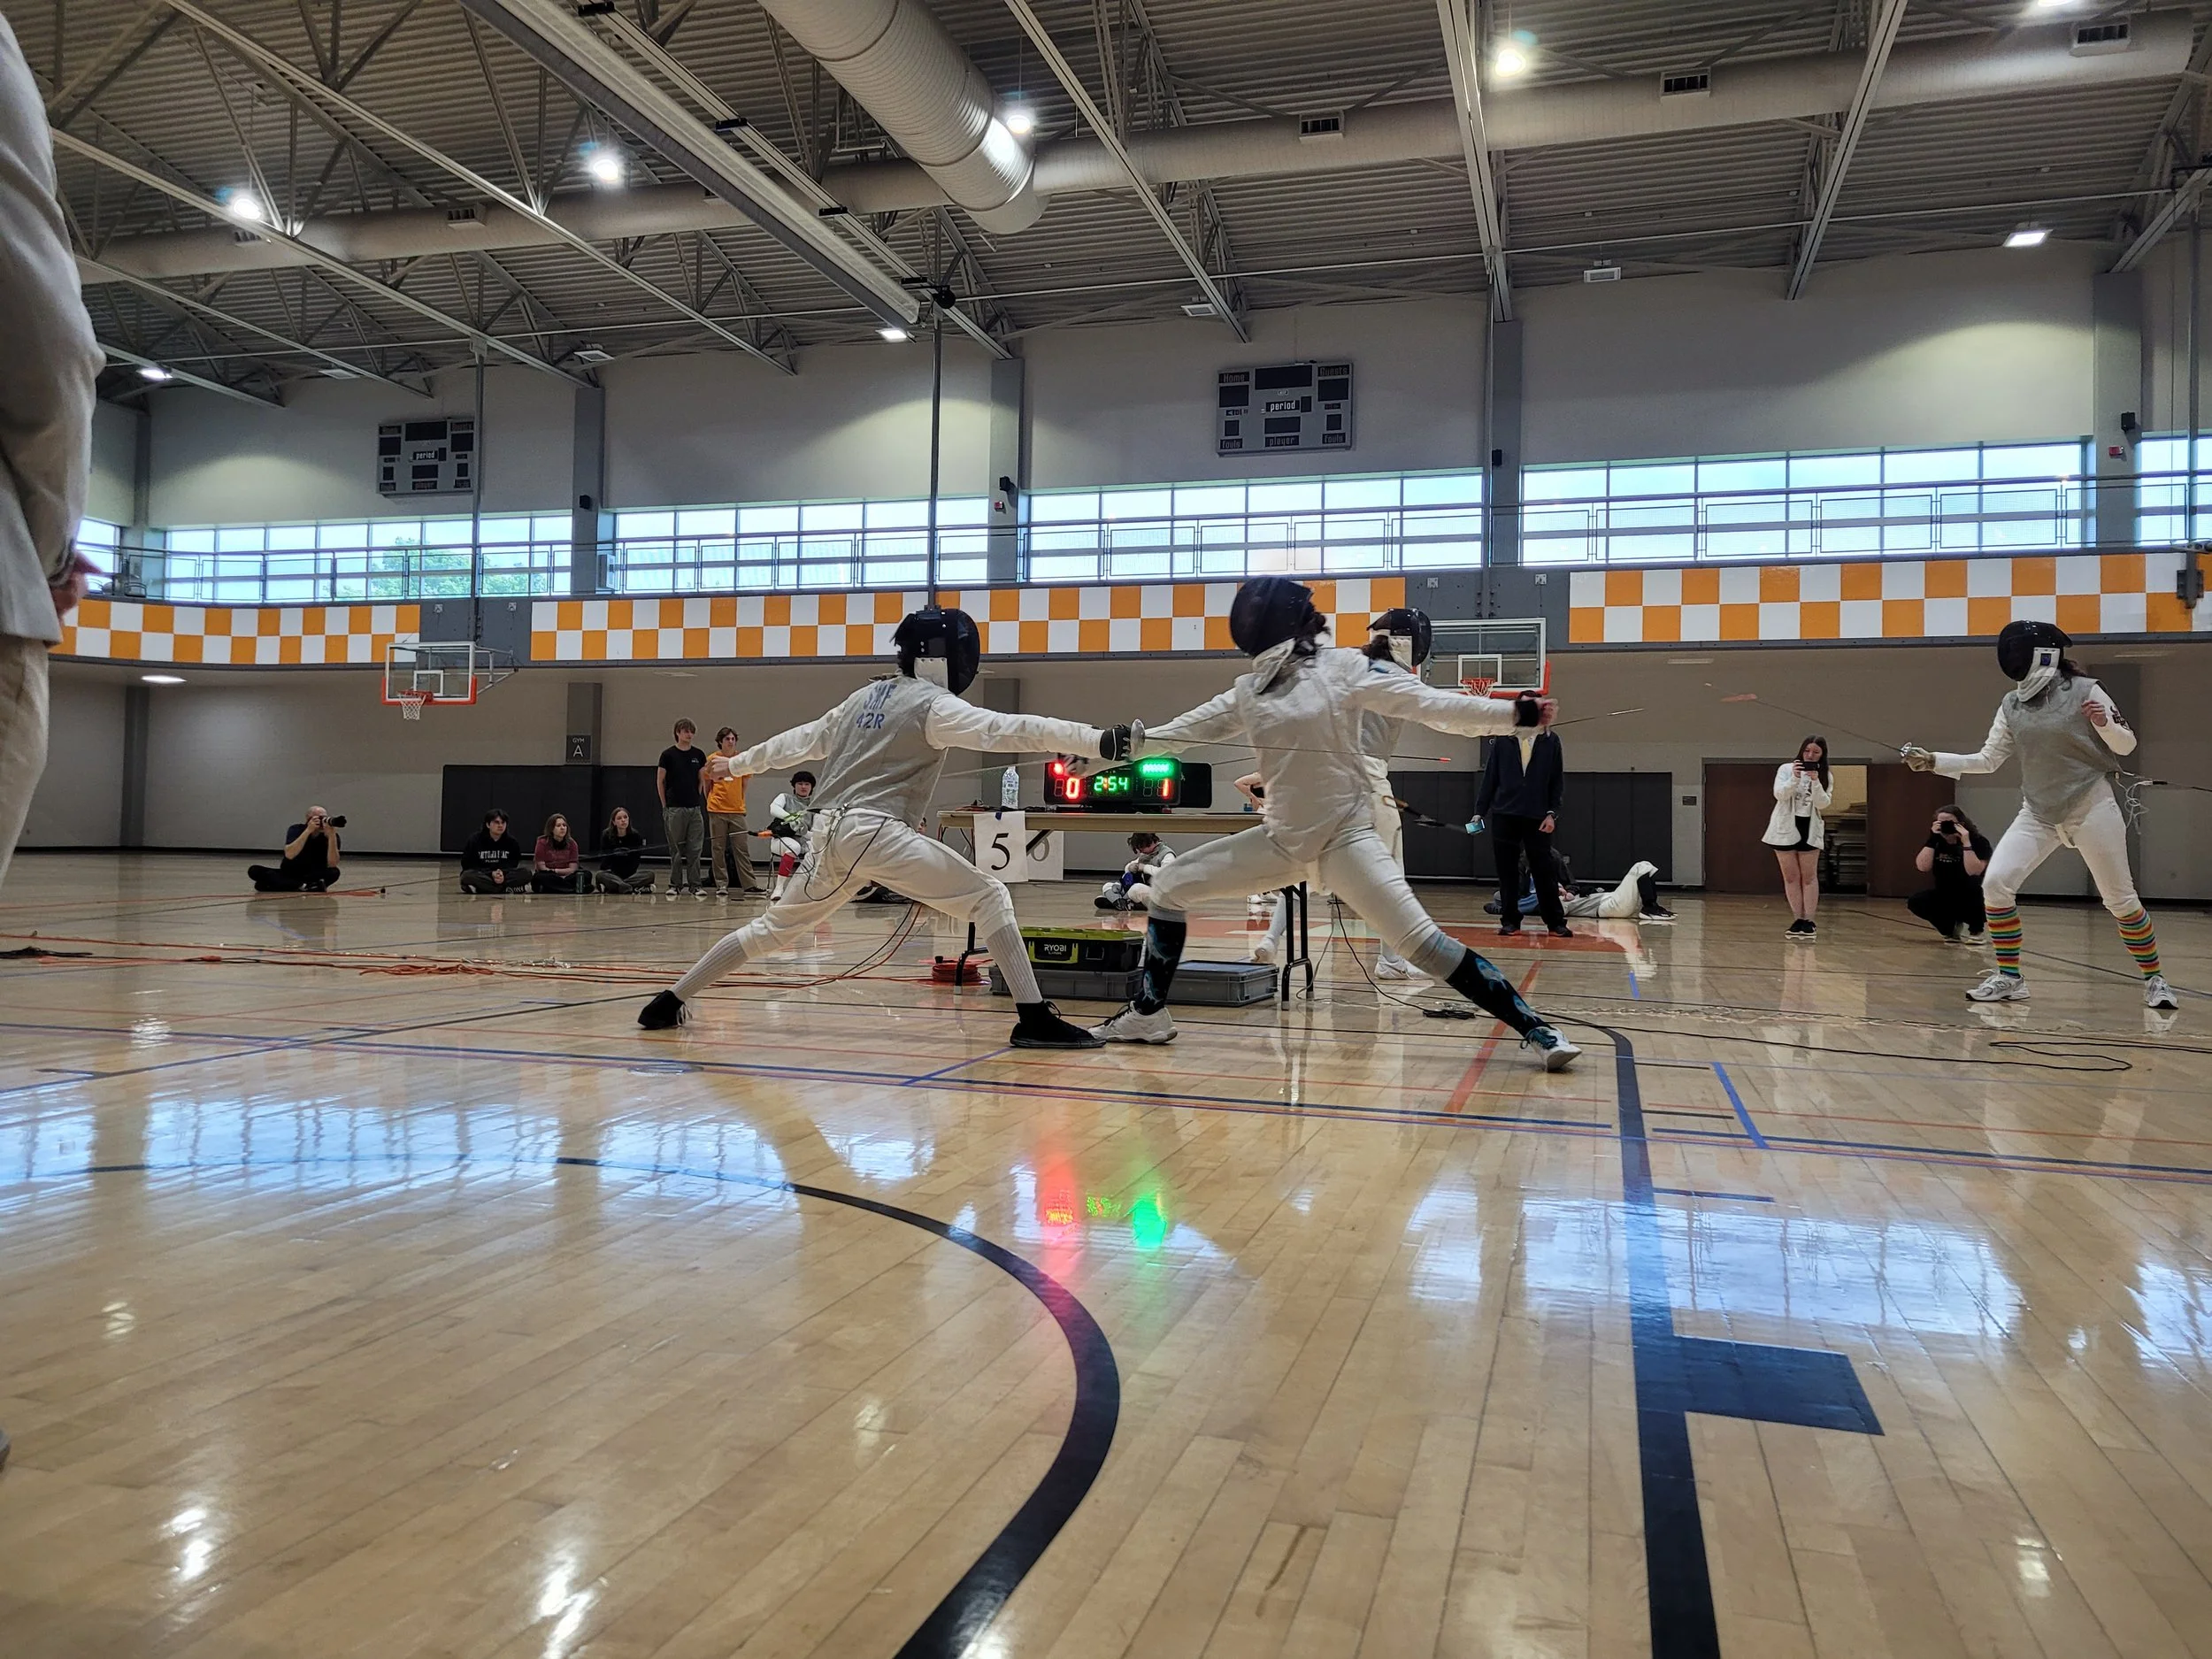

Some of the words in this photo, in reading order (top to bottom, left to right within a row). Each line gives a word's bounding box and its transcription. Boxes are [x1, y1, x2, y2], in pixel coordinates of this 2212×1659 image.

[1223, 373, 1245, 382] Home
[1270, 400, 1295, 412] period
[415, 451, 435, 460] period
[572, 744, 584, 757] A
[1065, 778, 1079, 799] 0
[1094, 776, 1128, 791] 2:54
[991, 833, 1010, 871] 5
[1044, 943, 1067, 952] RYOBI
